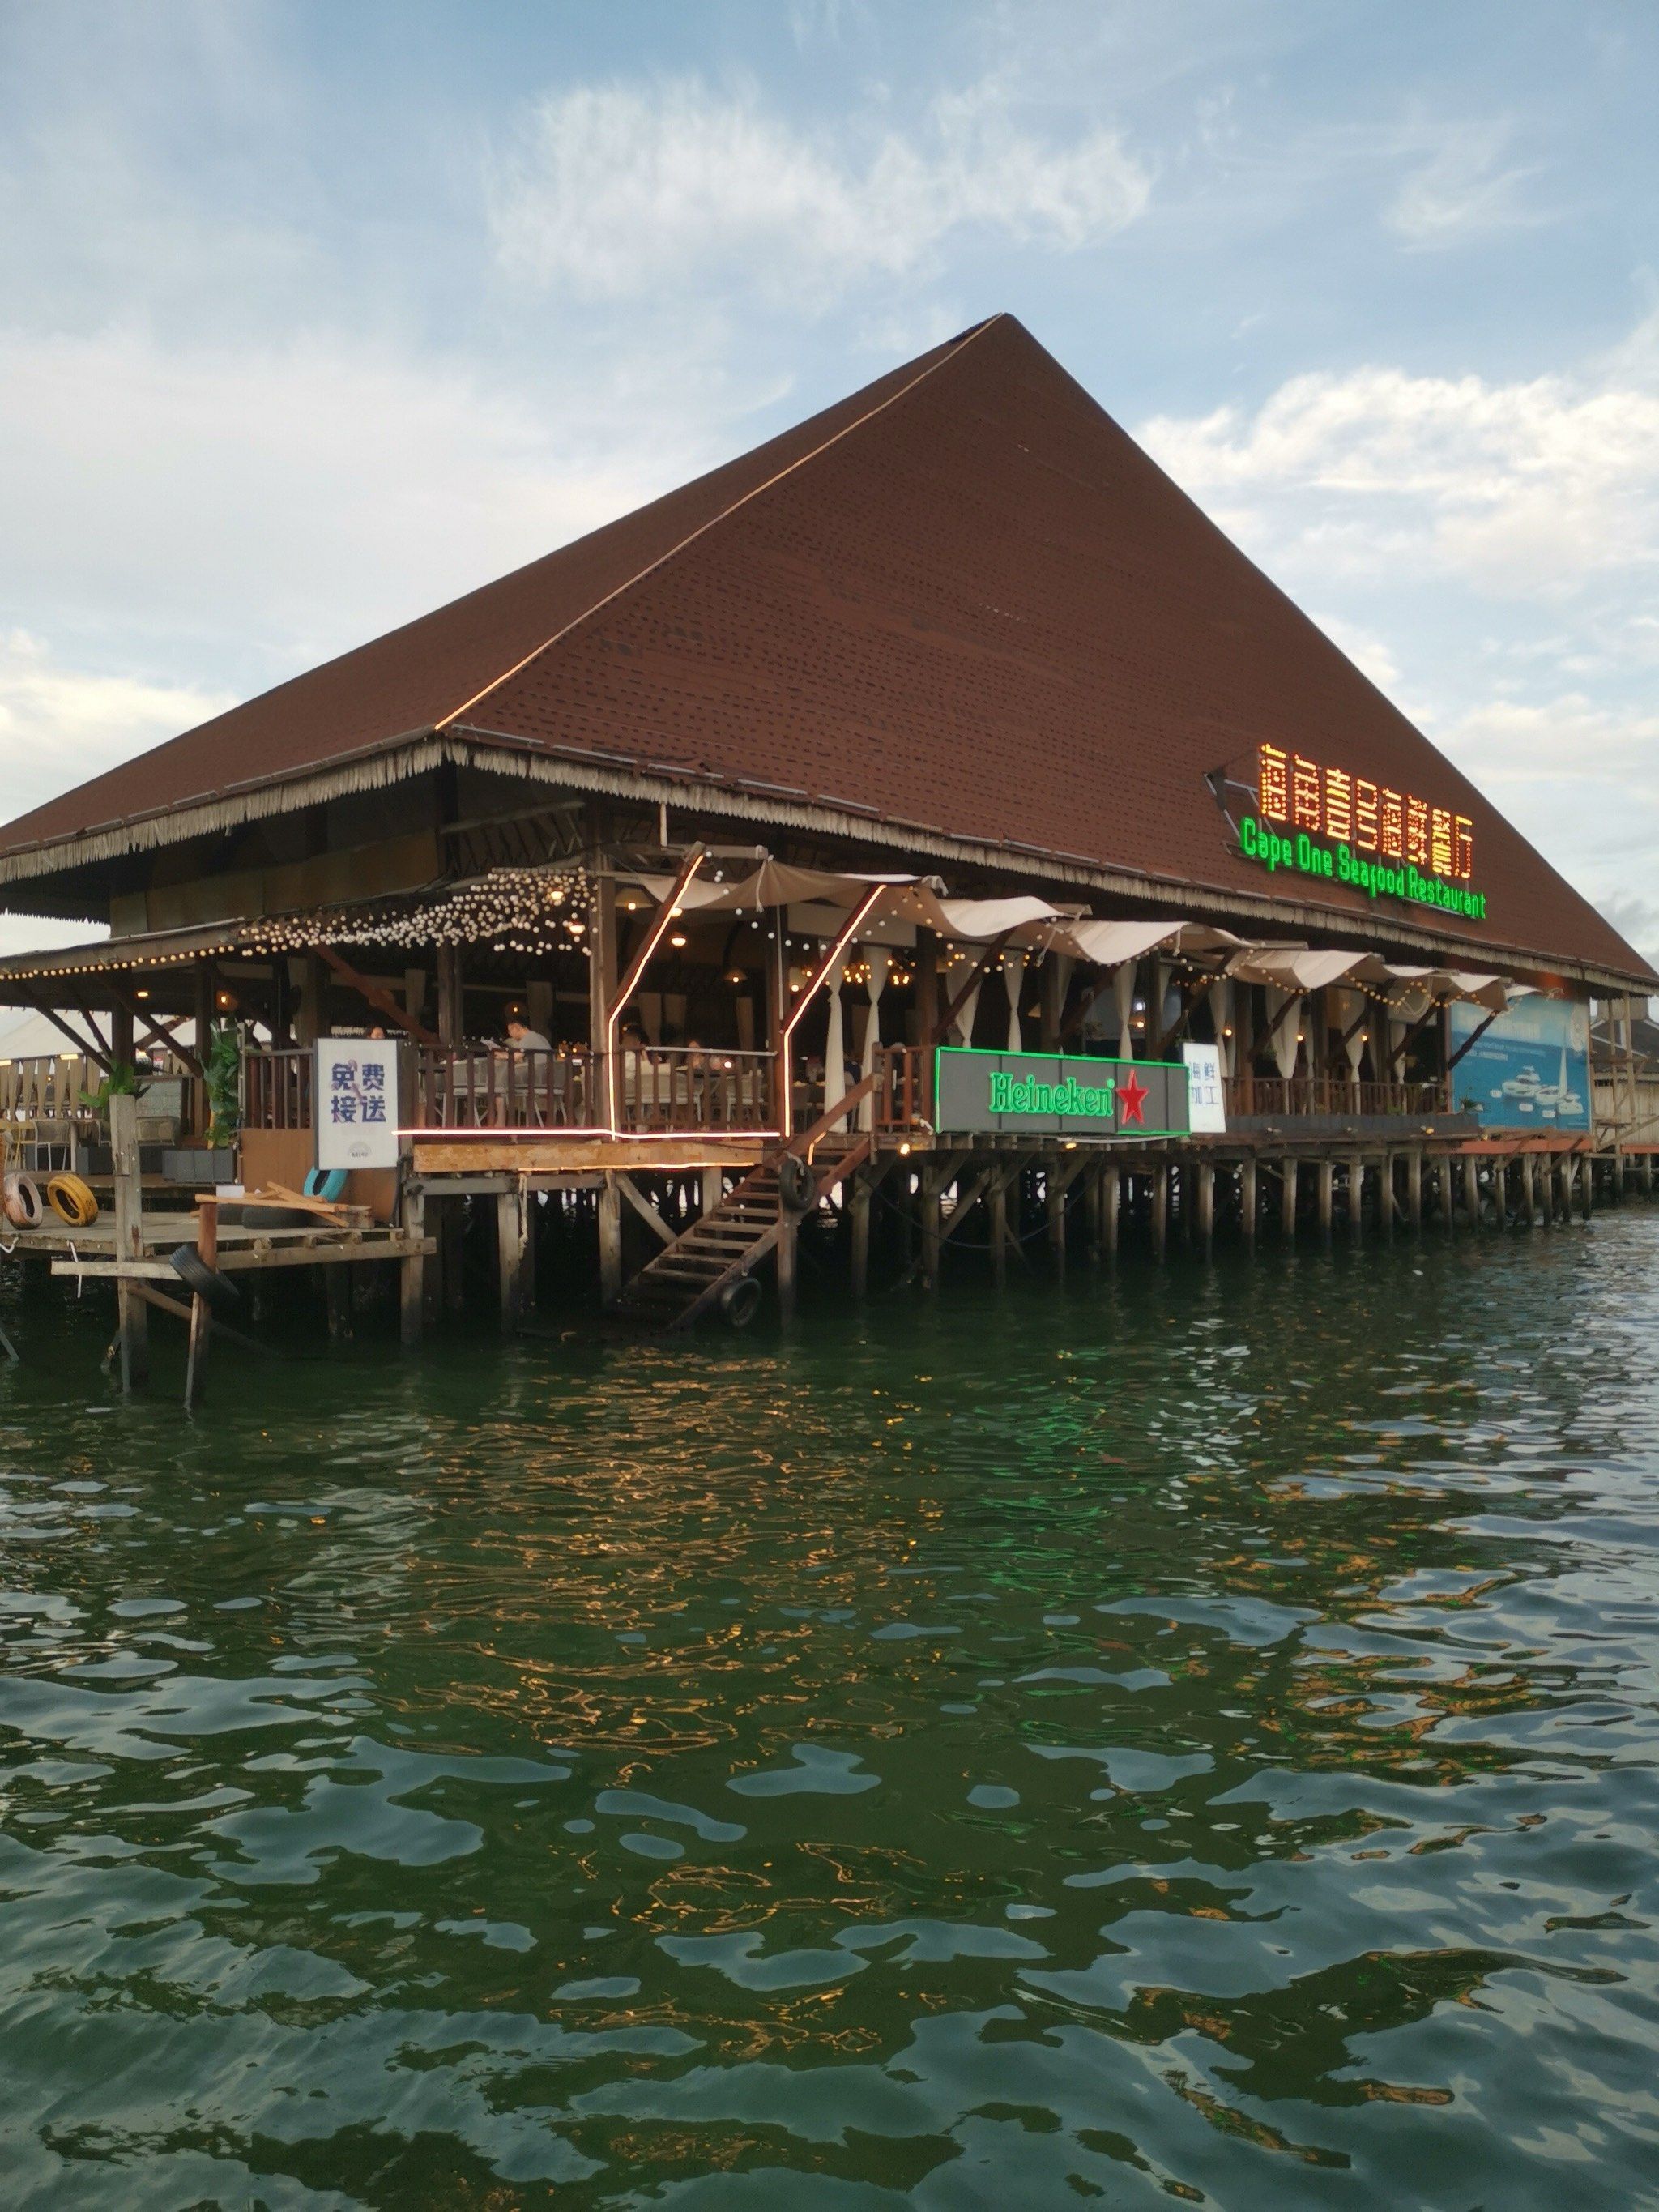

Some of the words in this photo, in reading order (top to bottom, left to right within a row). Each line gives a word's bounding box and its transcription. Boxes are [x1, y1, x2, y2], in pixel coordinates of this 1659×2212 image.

[1240, 816, 1293, 872] Cape
[1297, 833, 1333, 877] One
[1337, 843, 1405, 898] Seafood
[1406, 865, 1486, 920] Restaurant
[331, 1062, 385, 1091] 免费
[988, 1071, 1115, 1117] Heineken
[331, 1095, 386, 1124] 接送
